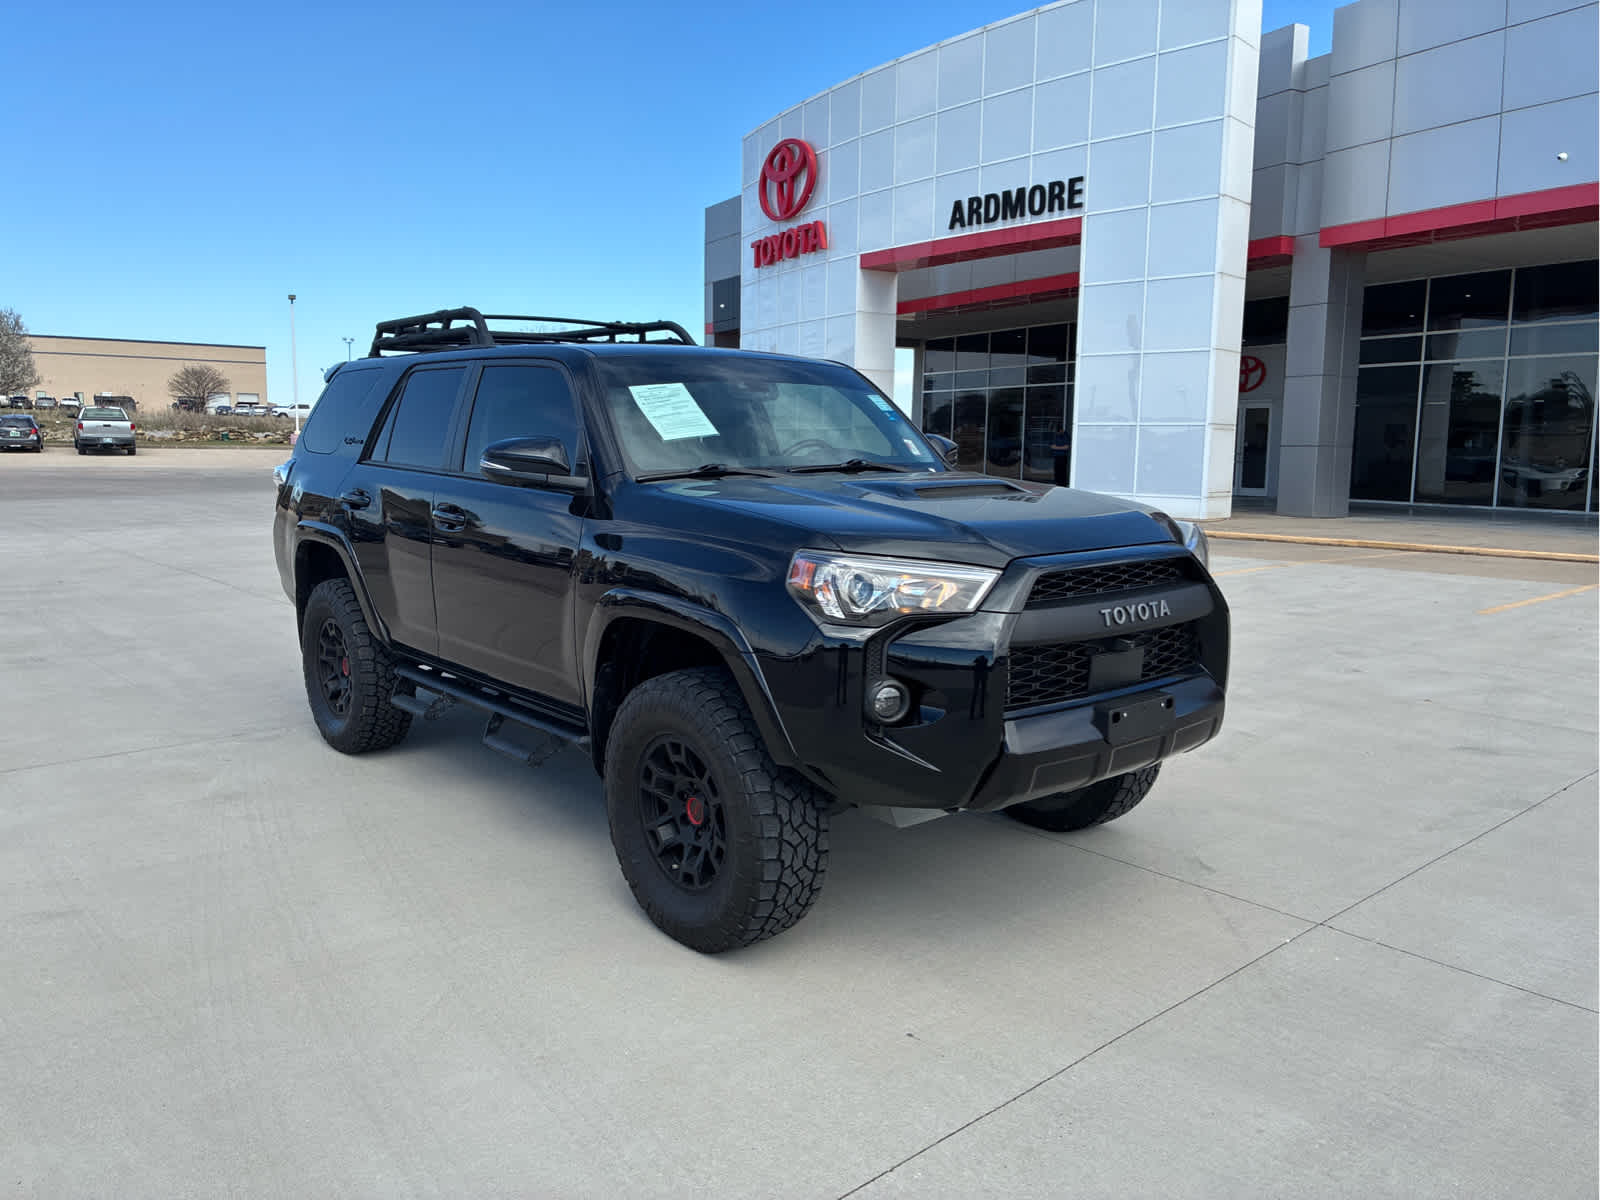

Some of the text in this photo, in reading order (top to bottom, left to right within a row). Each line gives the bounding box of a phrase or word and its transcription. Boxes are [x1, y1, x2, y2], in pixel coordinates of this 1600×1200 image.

[948, 176, 1084, 230] ARDMORE
[750, 220, 828, 269] TOYOTA
[1101, 599, 1171, 627] TOYOTA
